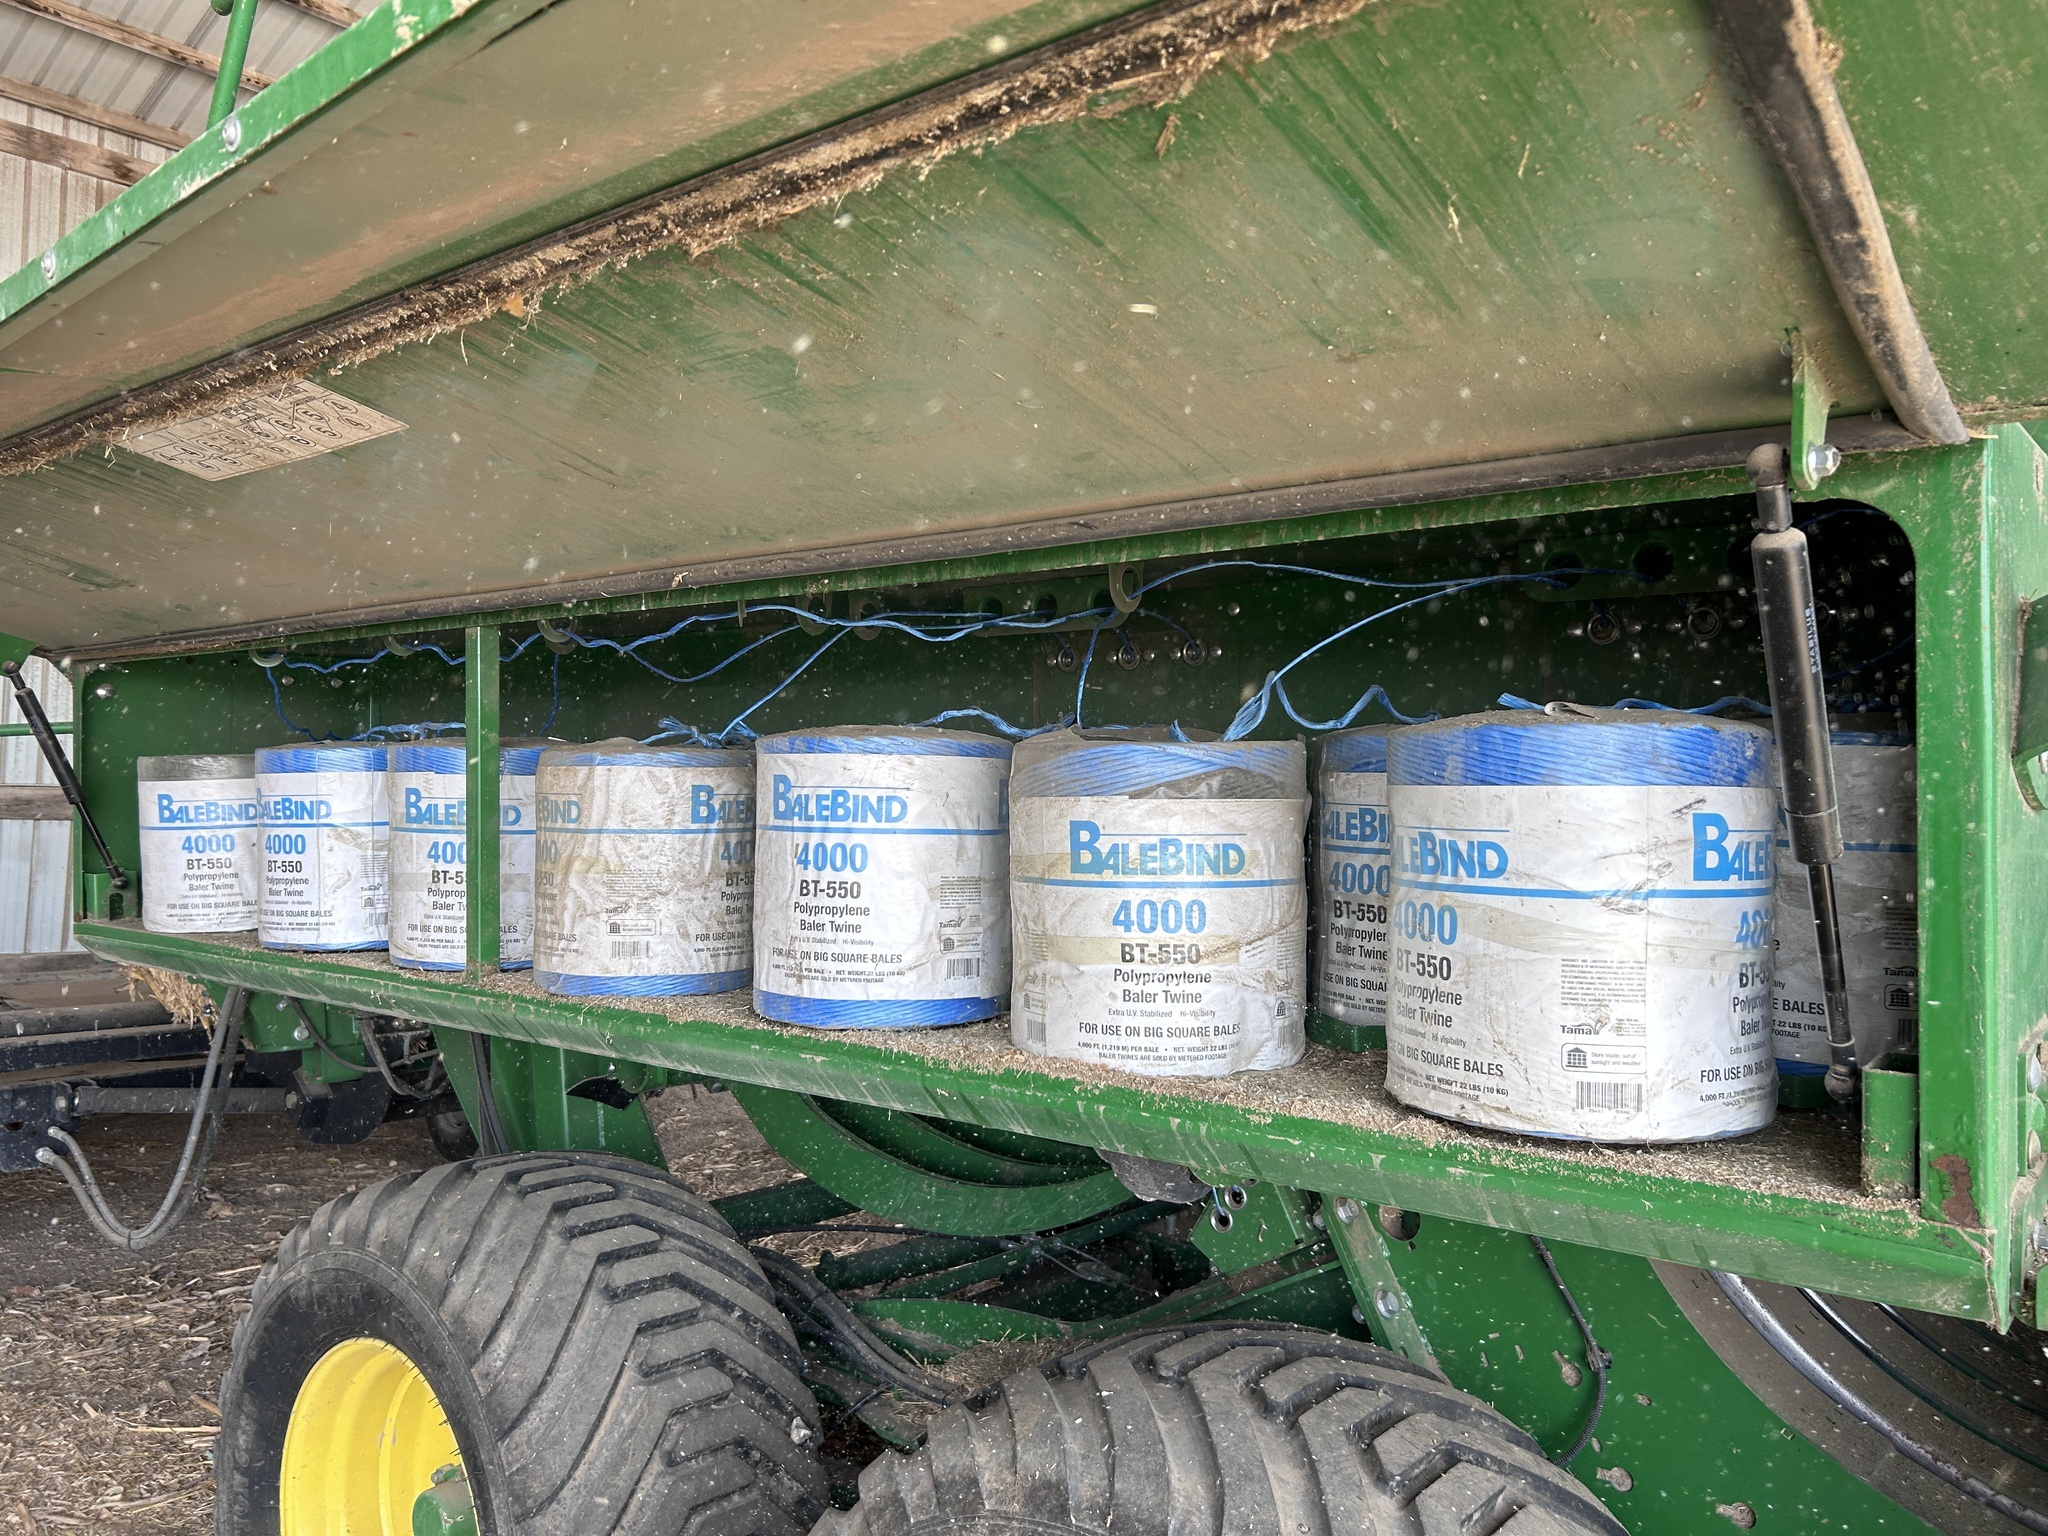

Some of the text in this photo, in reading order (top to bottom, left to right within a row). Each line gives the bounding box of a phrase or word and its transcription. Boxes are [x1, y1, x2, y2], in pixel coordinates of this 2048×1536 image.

[182, 834, 235, 854] 4000
[265, 834, 306, 855] 4000
[427, 841, 466, 864] 400
[796, 842, 868, 872] 4000
[186, 857, 232, 870] BT-550
[267, 860, 302, 873] BT-550
[184, 872, 239, 882] Polypropylene
[432, 870, 466, 884] BT-5
[726, 872, 755, 886] BT-55
[1329, 862, 1390, 898] 4000
[189, 882, 234, 892] Baler Twine
[268, 888, 304, 896] Baler Twine
[428, 887, 466, 898] Polyprop
[800, 879, 861, 899] BT-550
[432, 901, 455, 910] Baler
[794, 902, 870, 918] Polypropylene
[1333, 900, 1387, 924] BT-550
[1112, 899, 1207, 934] 4000
[1394, 900, 1458, 946] 4000
[800, 919, 862, 933] Baler Twine
[1330, 922, 1387, 942] Polypropyle
[712, 932, 726, 941] USE
[728, 932, 735, 940] ON
[772, 947, 784, 957] FOR
[800, 951, 811, 960] ON
[814, 951, 828, 962] BIG
[831, 952, 868, 963] SQUARE
[872, 954, 902, 963] BALES
[1120, 942, 1201, 964] BT-550
[1358, 945, 1388, 961] Twine
[1396, 947, 1452, 981] BT-550
[1883, 967, 1915, 977] Tama
[1114, 968, 1212, 986] Polypropylene
[1335, 974, 1344, 985] ON
[1346, 976, 1358, 988] BIG
[1361, 979, 1386, 992] SQUA
[1122, 989, 1202, 1004] Baler Twine
[1108, 1008, 1125, 1016] Extra
[1180, 1010, 1216, 1018] Hi-Visibility
[1397, 1000, 1453, 1028] Baler Twine
[1782, 999, 1825, 1015] BALES
[1079, 1022, 1241, 1038] FOR USE ON BIG SQUARE BALES
[1560, 1025, 1592, 1035] Tama
[1741, 1018, 1760, 1036] Baler
[1772, 1029, 1800, 1038] FOOTAGE
[1406, 1045, 1418, 1060] BIG
[1421, 1050, 1460, 1070] SQUARE
[1464, 1058, 1504, 1077] BALES
[1700, 1069, 1721, 1083] FOR
[1724, 1066, 1741, 1081] USE
[1743, 1063, 1753, 1077] ON
[1459, 1081, 1468, 1090] 22
[1468, 1082, 1482, 1092] LBS
[1483, 1083, 1494, 1094] (10
[1496, 1084, 1509, 1097] KG)
